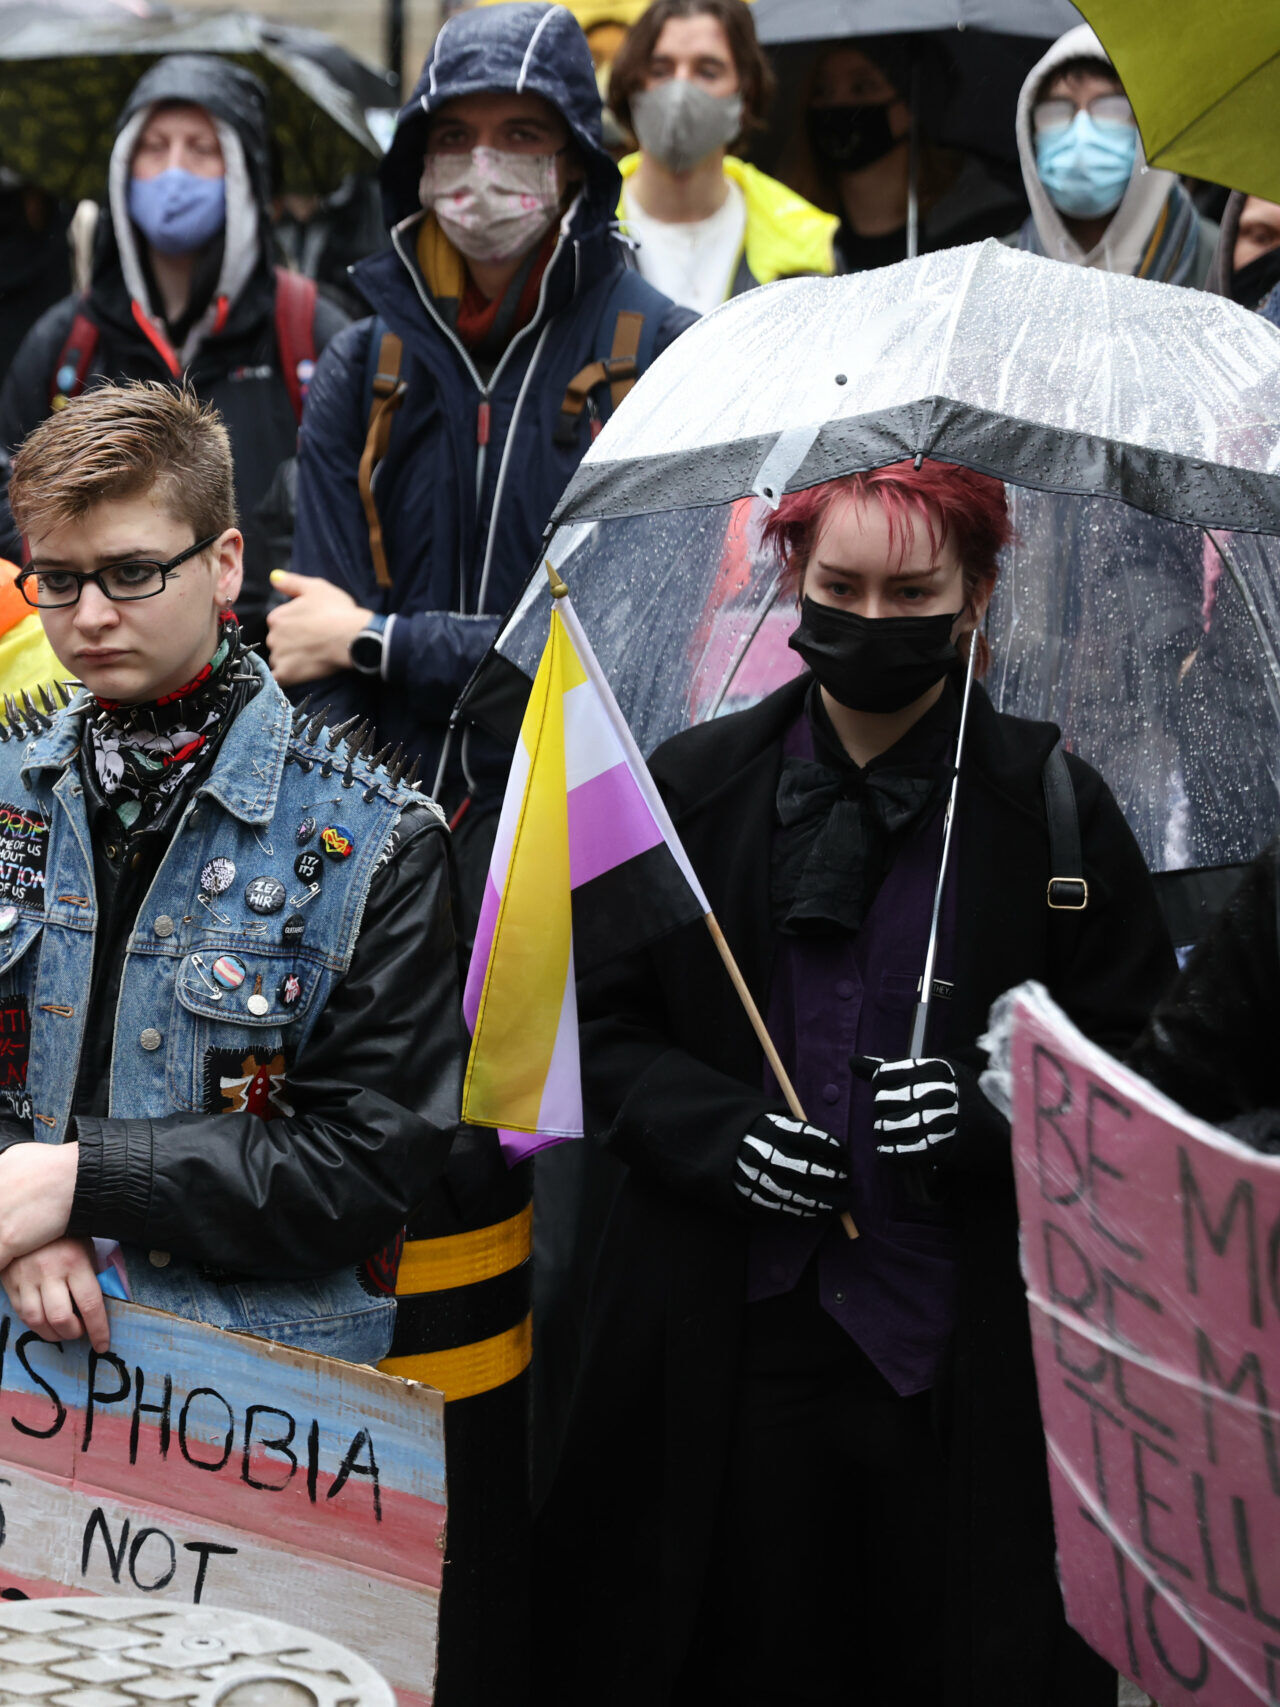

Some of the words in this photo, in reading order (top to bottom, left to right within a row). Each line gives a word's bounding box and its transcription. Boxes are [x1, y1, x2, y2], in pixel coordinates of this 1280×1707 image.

[27, 843, 41, 856] US
[298, 865, 315, 877] ITS
[11, 886, 26, 899] US
[249, 893, 273, 908] HIR
[1032, 1044, 1144, 1261] BE
[1042, 1219, 1176, 1438] BE
[1064, 1379, 1280, 1633] TELL
[81, 1507, 238, 1605] NOT
